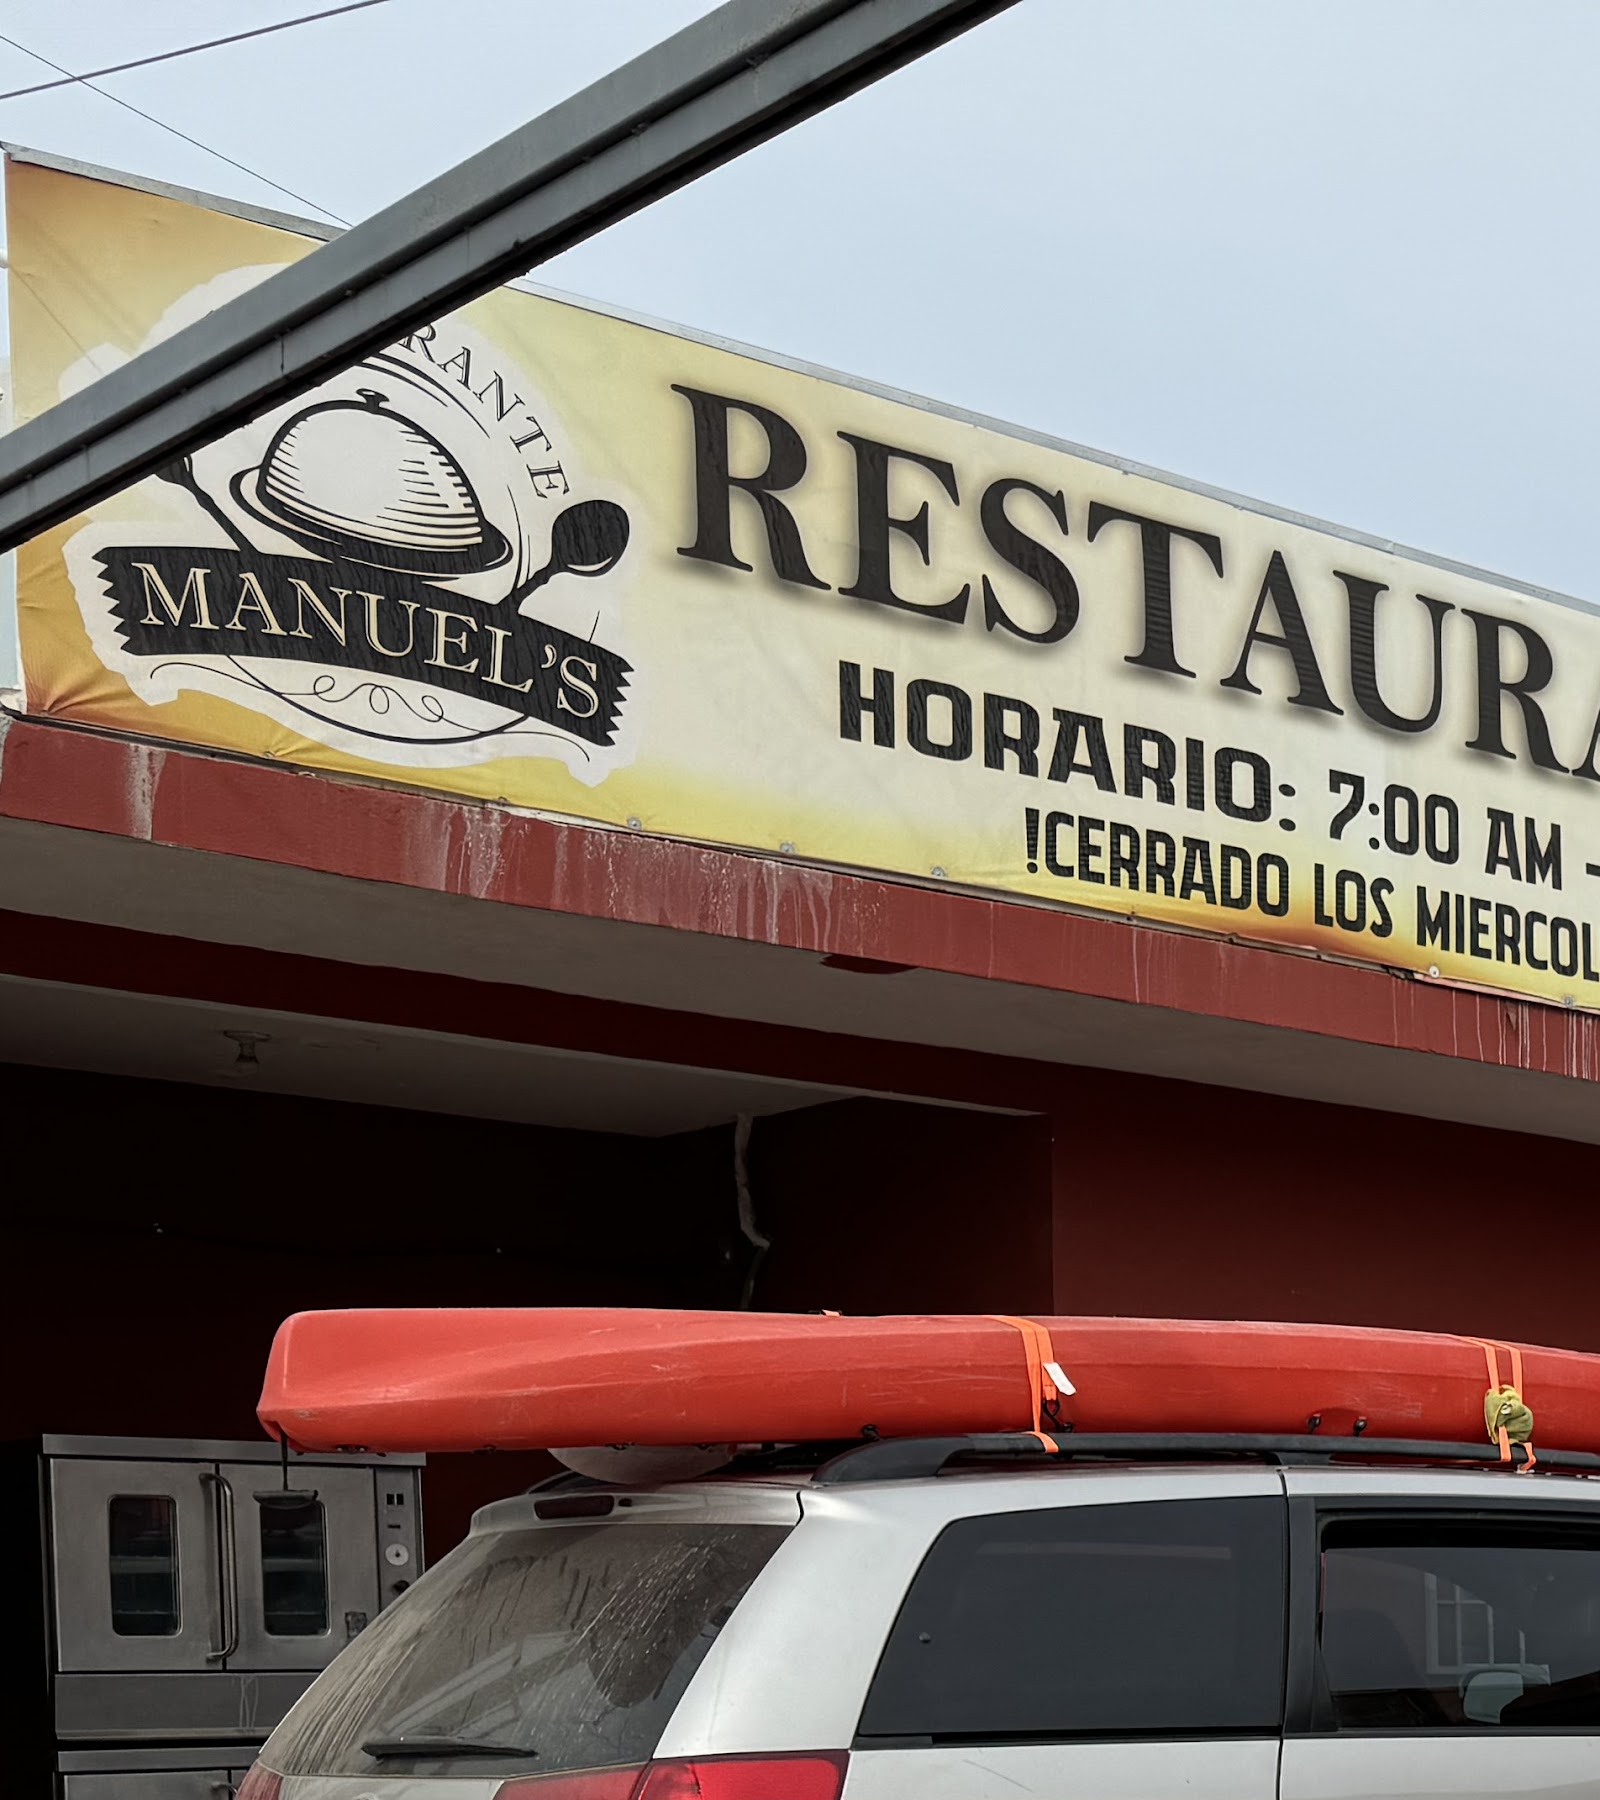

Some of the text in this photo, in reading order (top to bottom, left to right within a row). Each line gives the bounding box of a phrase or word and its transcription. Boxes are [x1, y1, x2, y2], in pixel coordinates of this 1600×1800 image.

[398, 324, 570, 499] RANTE
[131, 561, 599, 719] MANUEL'S
[839, 659, 1297, 832] HORARIO:
[1328, 769, 1459, 866] 7:00
[1485, 806, 1562, 890] AM
[1025, 807, 1290, 918] !CERRADO
[1314, 862, 1394, 938] LOS
